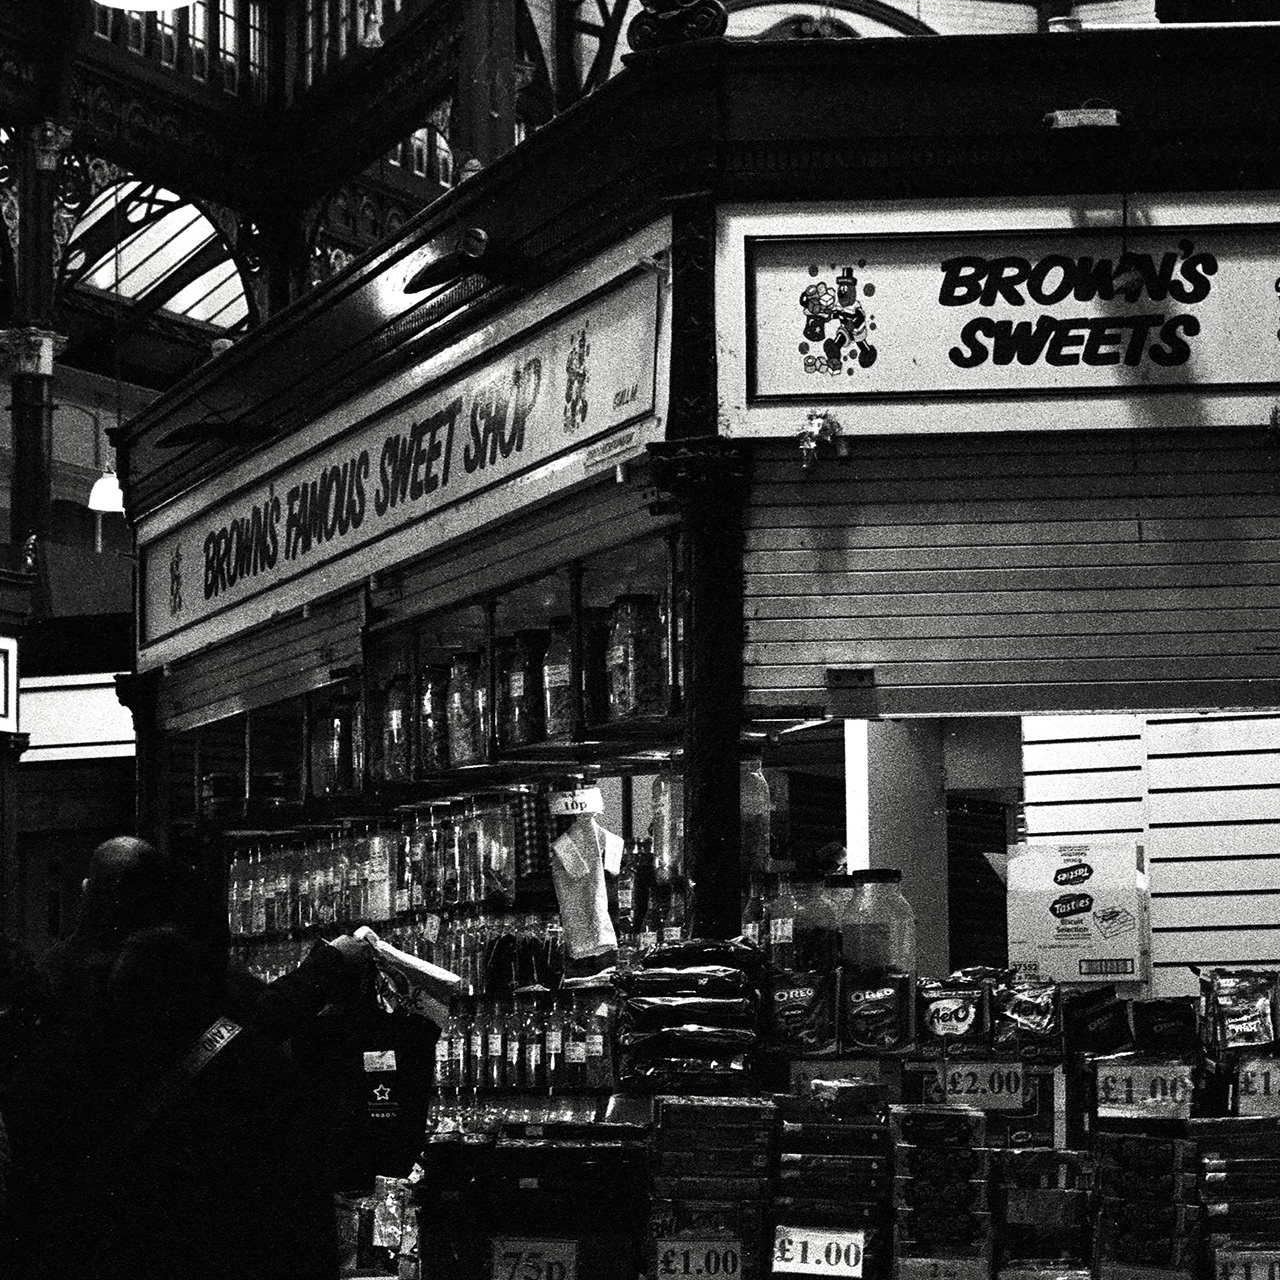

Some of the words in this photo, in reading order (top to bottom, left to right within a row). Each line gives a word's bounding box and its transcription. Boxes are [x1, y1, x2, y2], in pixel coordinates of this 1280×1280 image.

[937, 239, 1218, 307] BROWN'S
[948, 313, 1202, 368] SWEETS
[204, 481, 282, 601] BROWN'S
[285, 450, 369, 561] FAMOUS
[374, 396, 464, 517] SWEET
[463, 357, 542, 475] SHOP
[774, 987, 815, 1002] OREO
[948, 1071, 1020, 1095] £2.00
[659, 1248, 739, 1276] £1.00
[772, 1237, 862, 1268] £1.00
